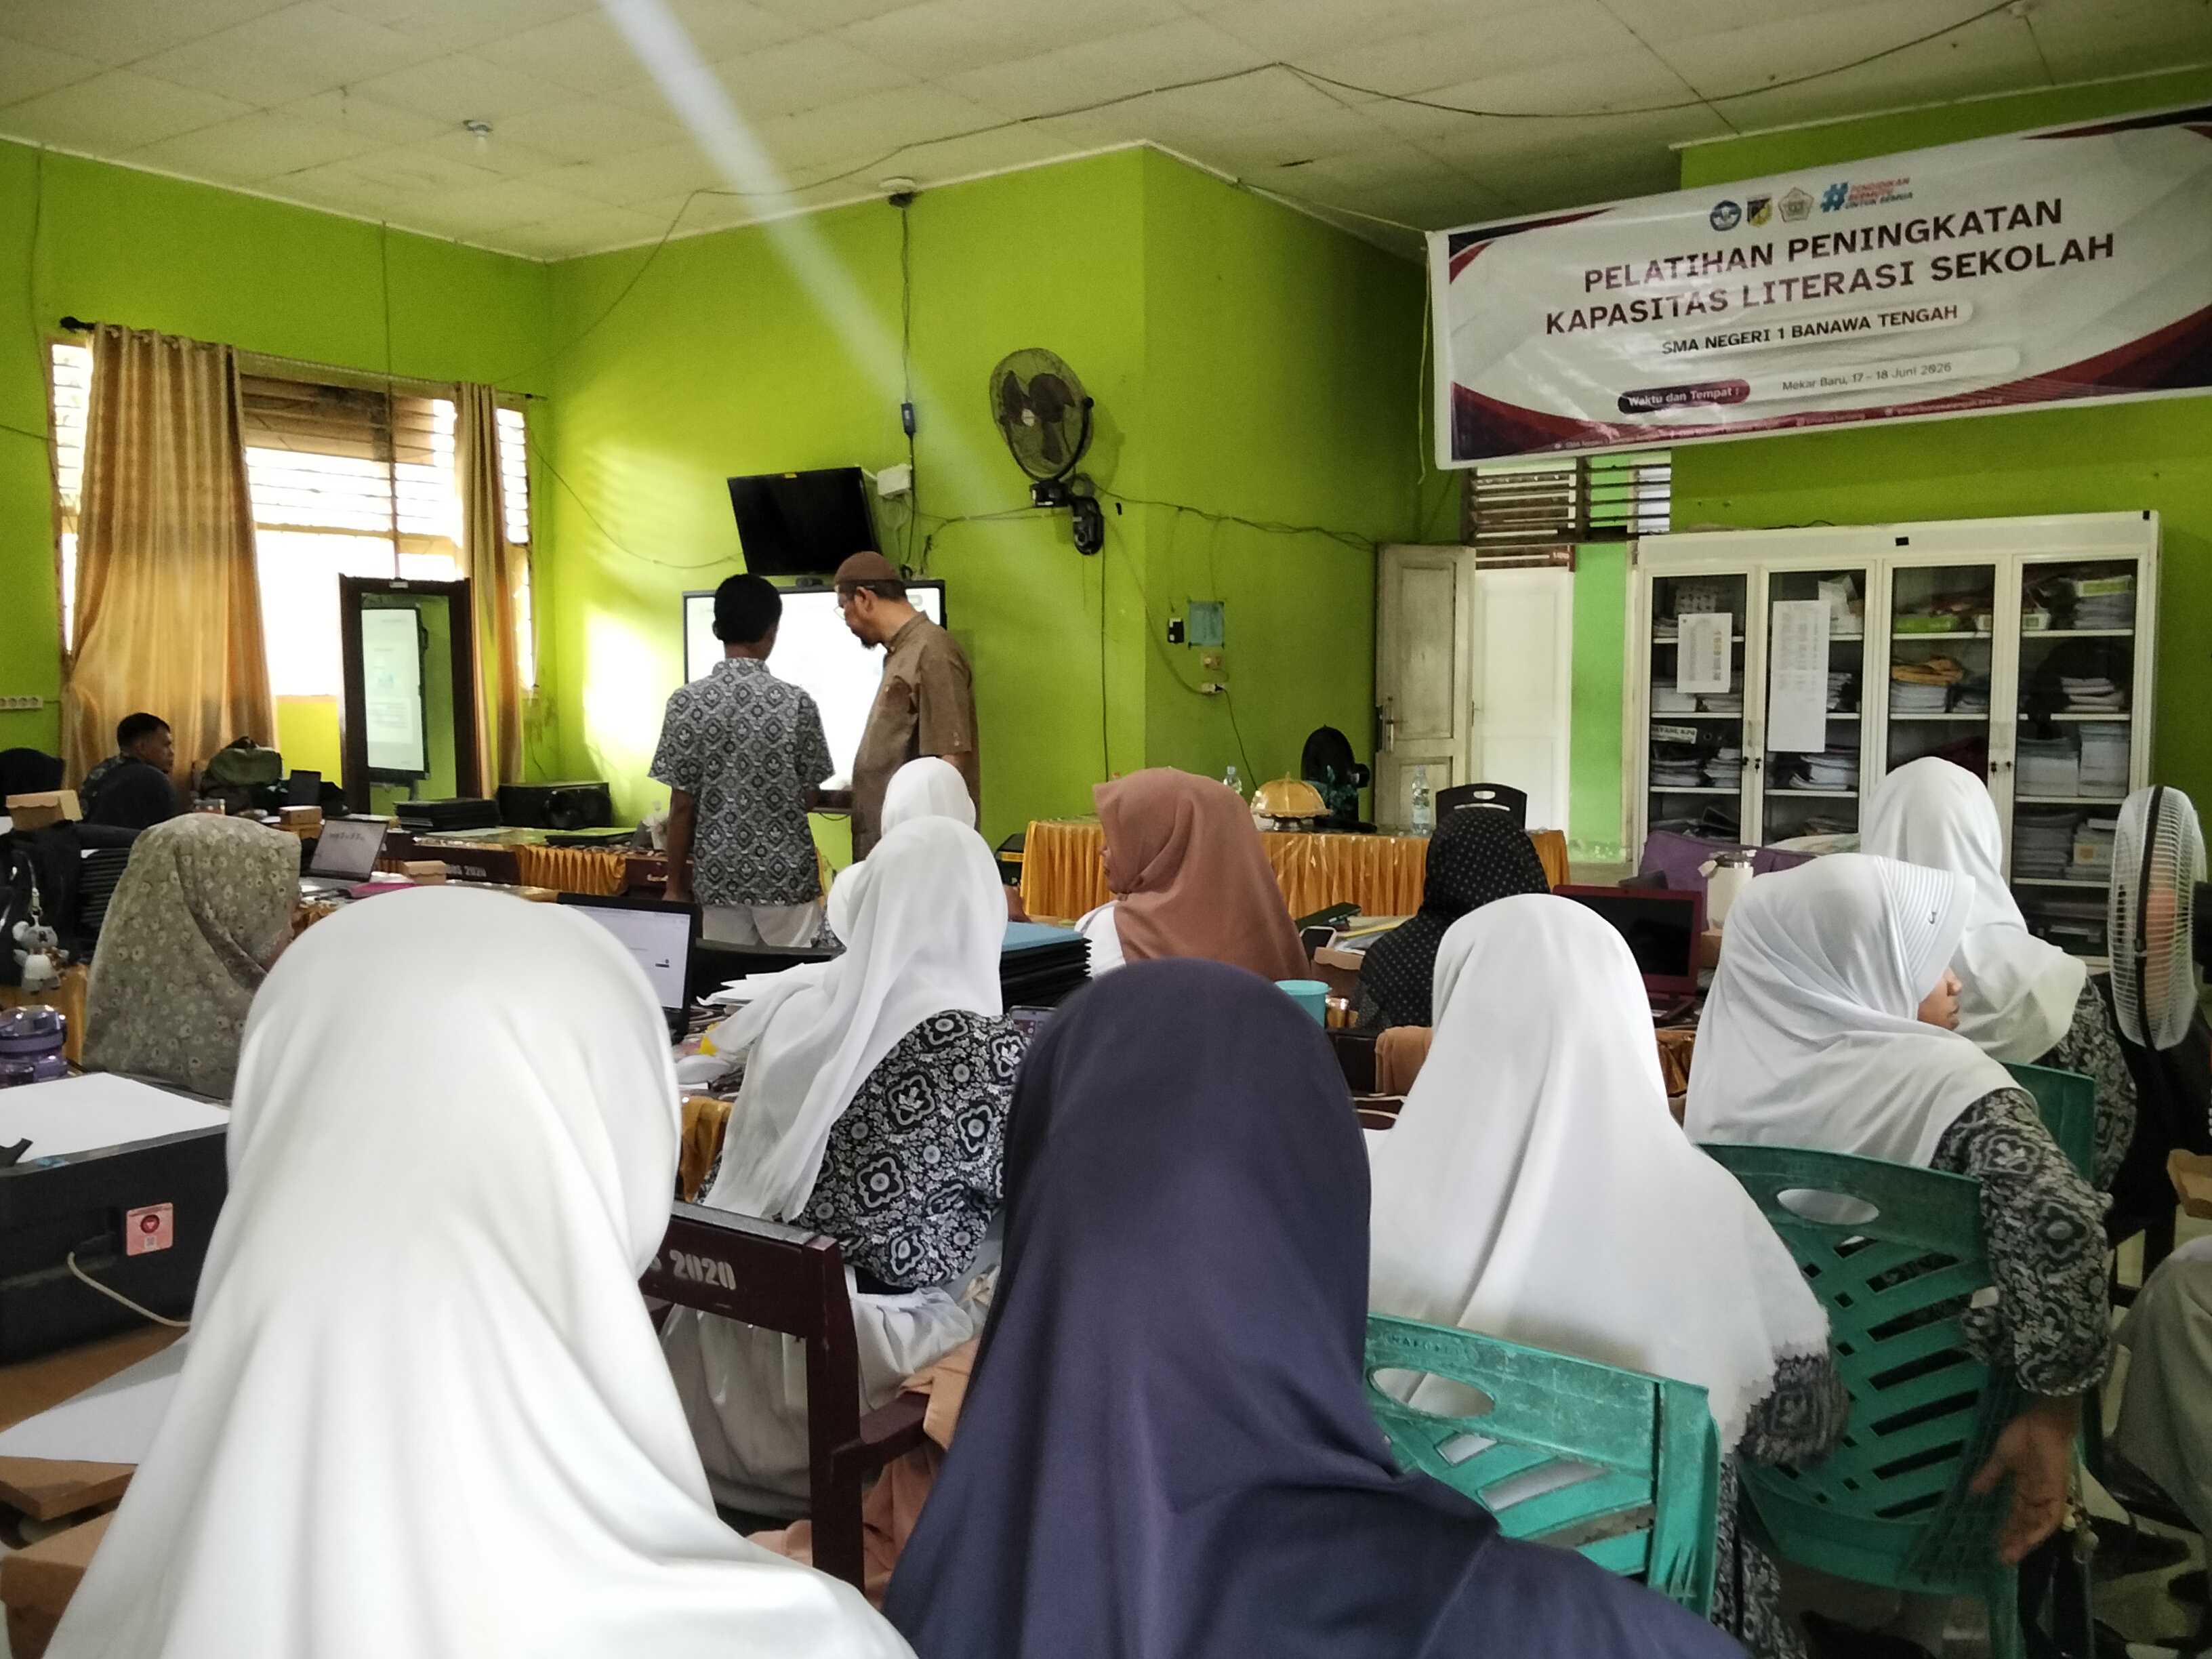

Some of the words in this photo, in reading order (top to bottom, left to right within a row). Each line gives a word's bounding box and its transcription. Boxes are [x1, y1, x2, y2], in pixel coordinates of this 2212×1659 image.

[1584, 242, 1773, 293] PELATIHAN
[1788, 198, 2062, 262] PENINGKATAN
[1546, 289, 1728, 334] KAPASITAS
[1743, 260, 1914, 308] LITERASI
[1931, 232, 2113, 282] SEKOLAH
[1662, 339, 1699, 354] SMA
[1705, 329, 1771, 349] NEGERI
[1778, 327, 1784, 340] 1
[1791, 316, 1871, 338] BANAWA
[1877, 305, 1957, 327] TENGAH
[1852, 373, 1864, 383] 17
[1876, 370, 1888, 380] 18
[1893, 366, 1917, 379] Juni
[1921, 362, 1952, 375] 2026
[1629, 396, 1663, 407] Waktu
[1665, 392, 1687, 402] dan
[1690, 388, 1733, 400] Tempat
[669, 1249, 737, 1290] 2020
